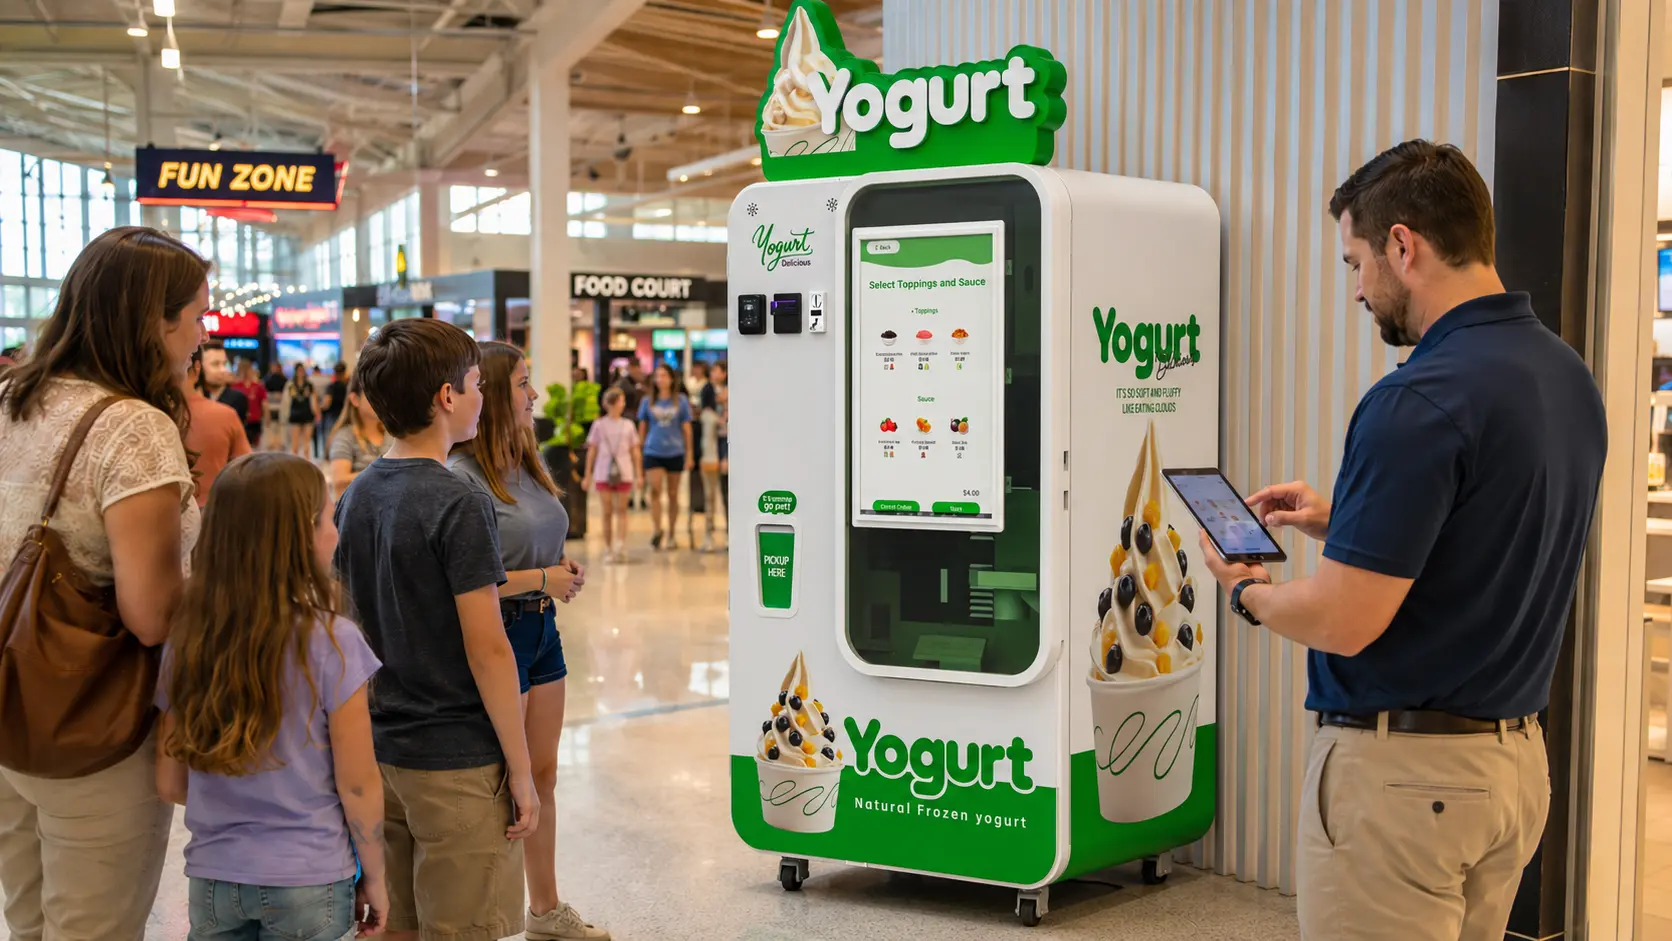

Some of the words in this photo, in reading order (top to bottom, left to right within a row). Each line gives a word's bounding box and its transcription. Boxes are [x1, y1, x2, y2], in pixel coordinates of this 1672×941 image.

[806, 56, 1036, 149] Yogurt
[158, 160, 223, 190] FUN
[229, 163, 317, 192] ZONE
[752, 223, 815, 272] Yogurt
[781, 259, 811, 267] Delicious
[574, 275, 629, 297] FOOD
[631, 277, 692, 299] COURT
[869, 281, 896, 290] Select
[897, 279, 938, 290] Toppings
[939, 278, 957, 287] and
[958, 277, 986, 287] Sauce
[1093, 306, 1201, 380] Yogurt
[763, 555, 790, 565] PICKUP
[767, 568, 786, 577] HERE
[844, 716, 1035, 800] Yogurt
[854, 797, 911, 815] Natural
[917, 804, 969, 821] Frozen
[975, 812, 1028, 829] yogurt
